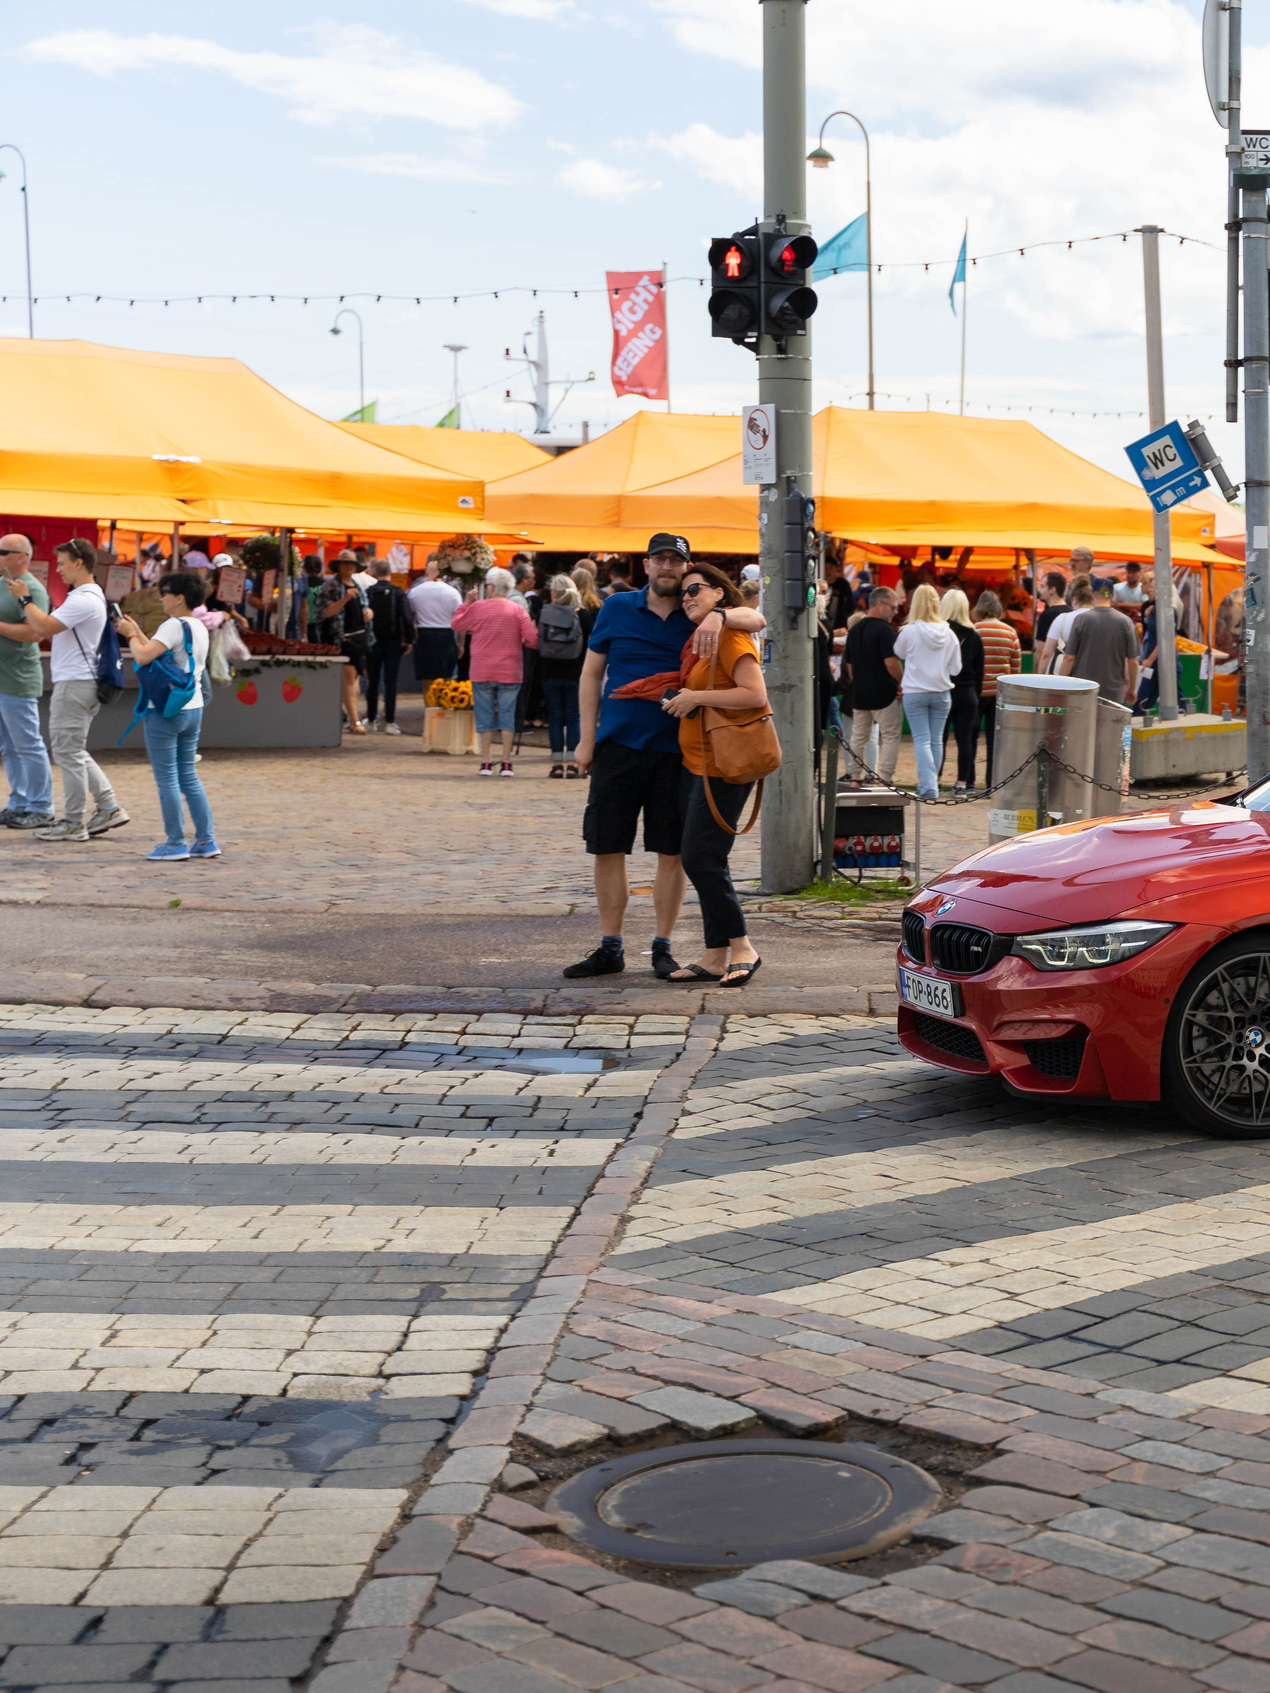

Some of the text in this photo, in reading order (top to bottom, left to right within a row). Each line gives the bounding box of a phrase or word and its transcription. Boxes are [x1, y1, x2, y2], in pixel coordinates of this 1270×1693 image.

[1244, 136, 1270, 149] WC
[613, 274, 659, 337] SIGHT
[613, 322, 663, 381] SEEING
[1146, 444, 1178, 471] WC
[905, 975, 949, 1011] FOP-866
